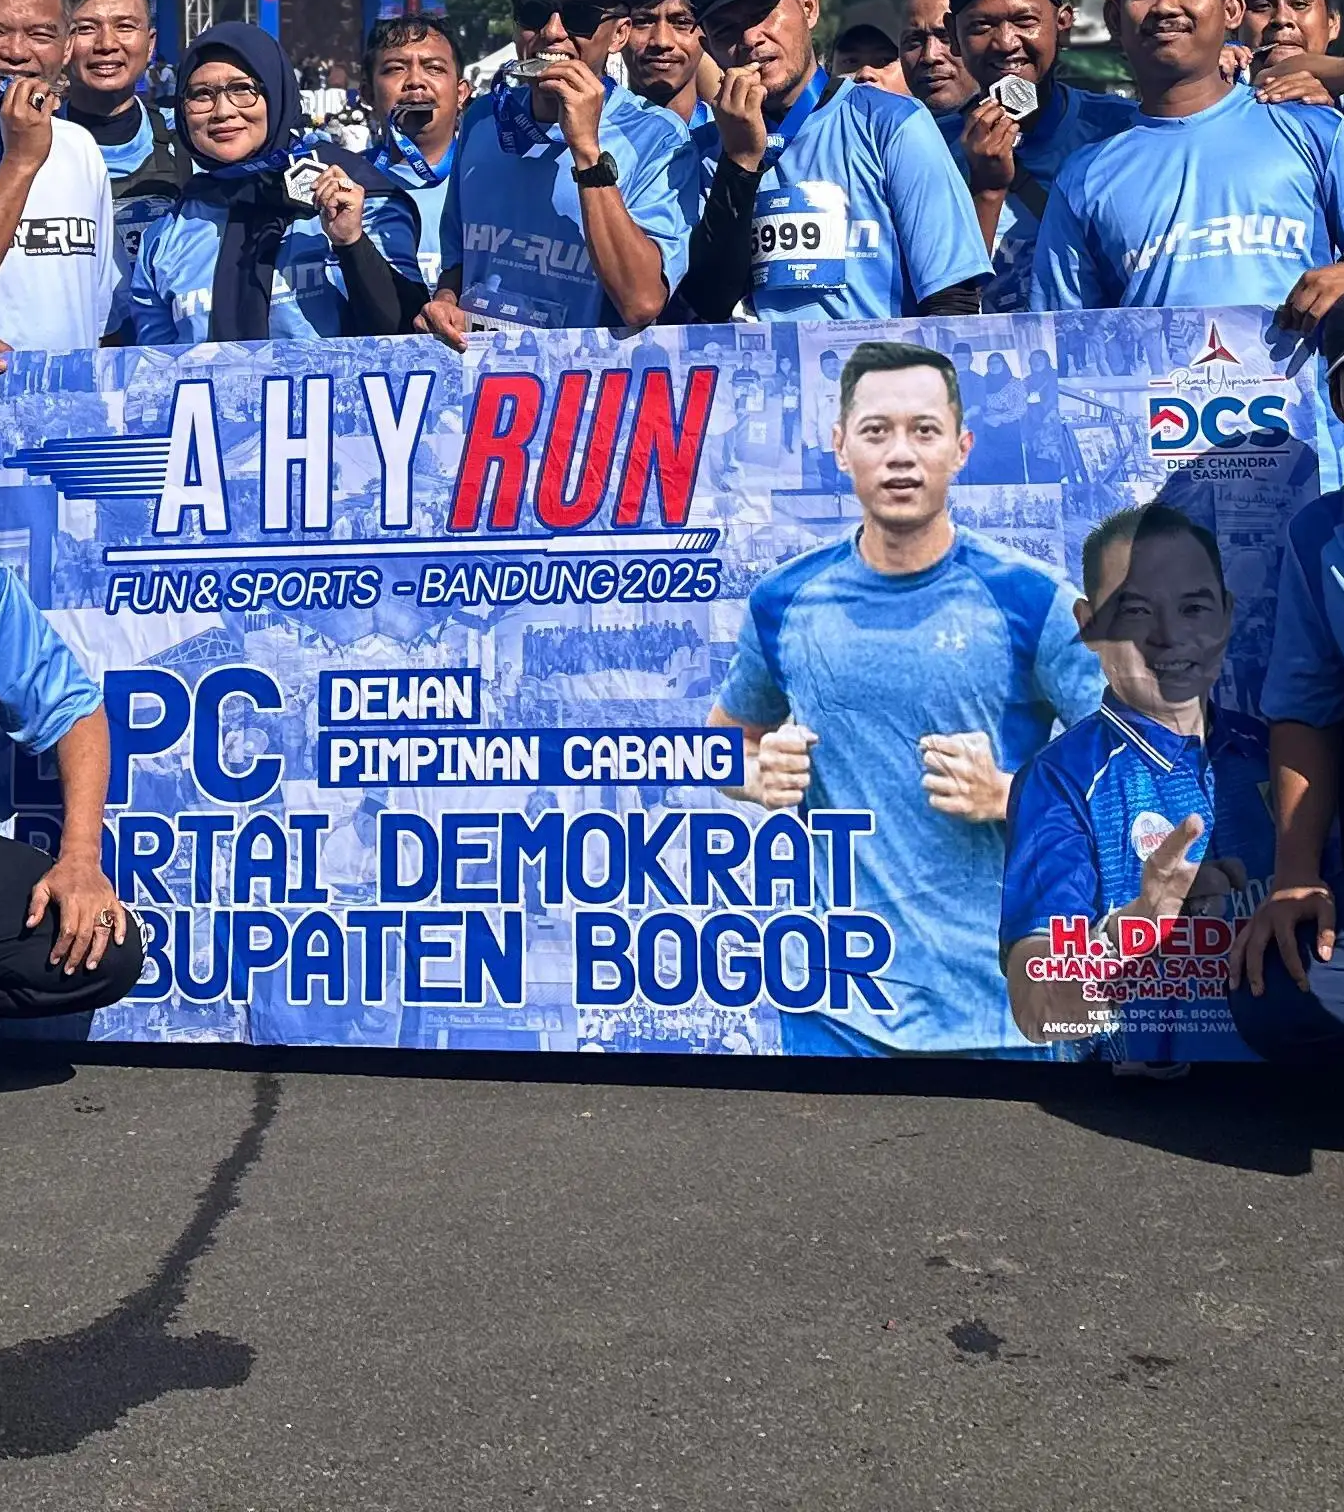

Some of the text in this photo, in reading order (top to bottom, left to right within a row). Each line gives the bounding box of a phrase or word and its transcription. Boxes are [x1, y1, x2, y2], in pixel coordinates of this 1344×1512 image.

[10, 219, 96, 255] Y-RUN
[753, 221, 821, 253] 999
[1150, 395, 1290, 449] DCS
[153, 366, 719, 536] AHY RUN
[1167, 457, 1277, 469] DEDE CHANDRA
[1192, 469, 1253, 480] SASMITA
[105, 571, 191, 615] FUN
[192, 572, 222, 609] &
[226, 564, 382, 612] SPORTS
[417, 561, 620, 607] BANDUNG
[620, 559, 721, 603] 2025
[330, 678, 473, 720] DEWAN
[329, 734, 733, 784] PIMPINAN CABANG
[377, 809, 876, 912] DEMOKRAT
[1049, 914, 1252, 958] H. DED
[108, 910, 896, 1014] BUPATEN BOGOR
[1026, 957, 1160, 982] CHANDRA
[1139, 982, 1196, 1003] M.Pd,
[1042, 1022, 1238, 1034] ANGGOTA DPRD PROVINSI JAWA
[1088, 1009, 1127, 1020] KETUA
[1129, 1009, 1156, 1020] DPC
[1158, 1009, 1188, 1020] KAB.
